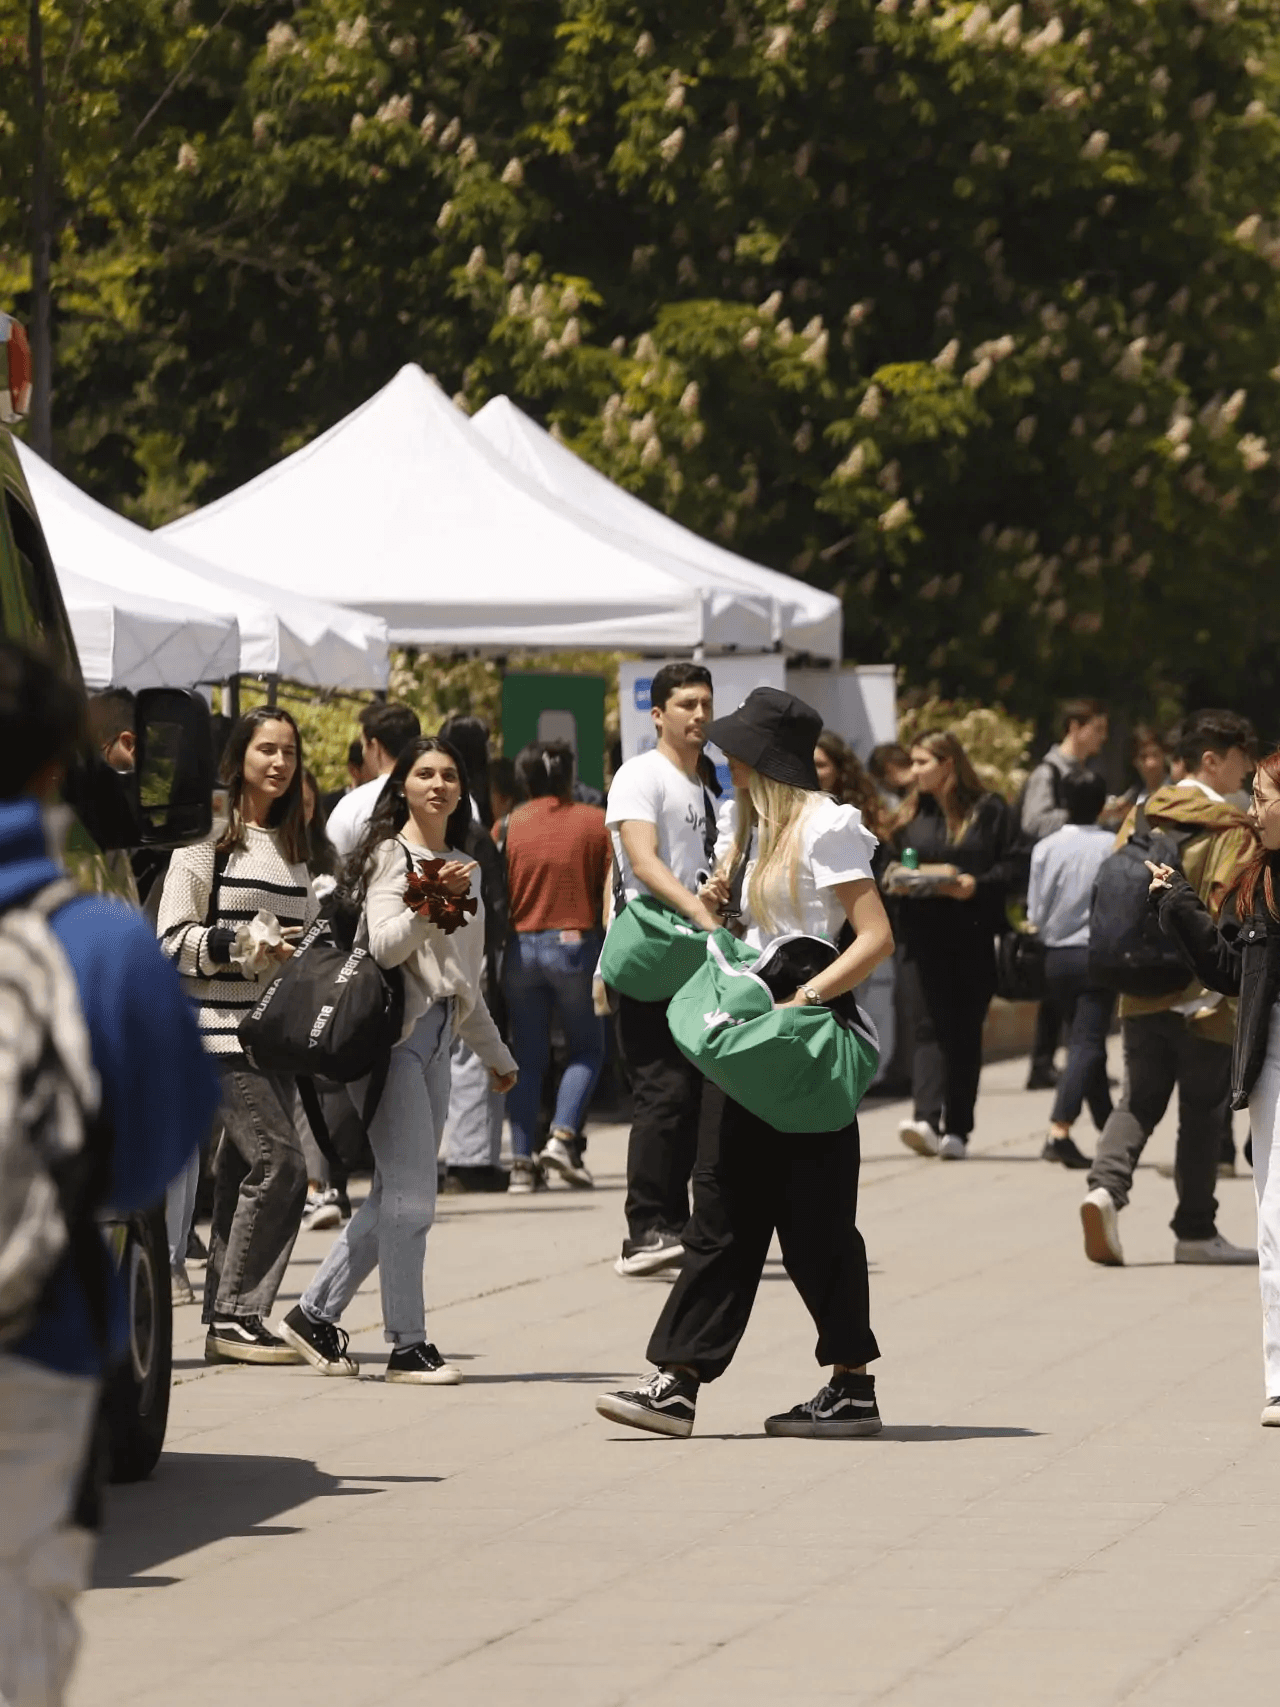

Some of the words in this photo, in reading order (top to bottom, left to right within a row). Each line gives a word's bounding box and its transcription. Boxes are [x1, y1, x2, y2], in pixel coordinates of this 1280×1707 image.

[293, 918, 329, 958] BUBBA
[335, 947, 367, 984] BUBBA
[251, 977, 283, 1021] BUBBA
[308, 1005, 335, 1049] BUBBA
